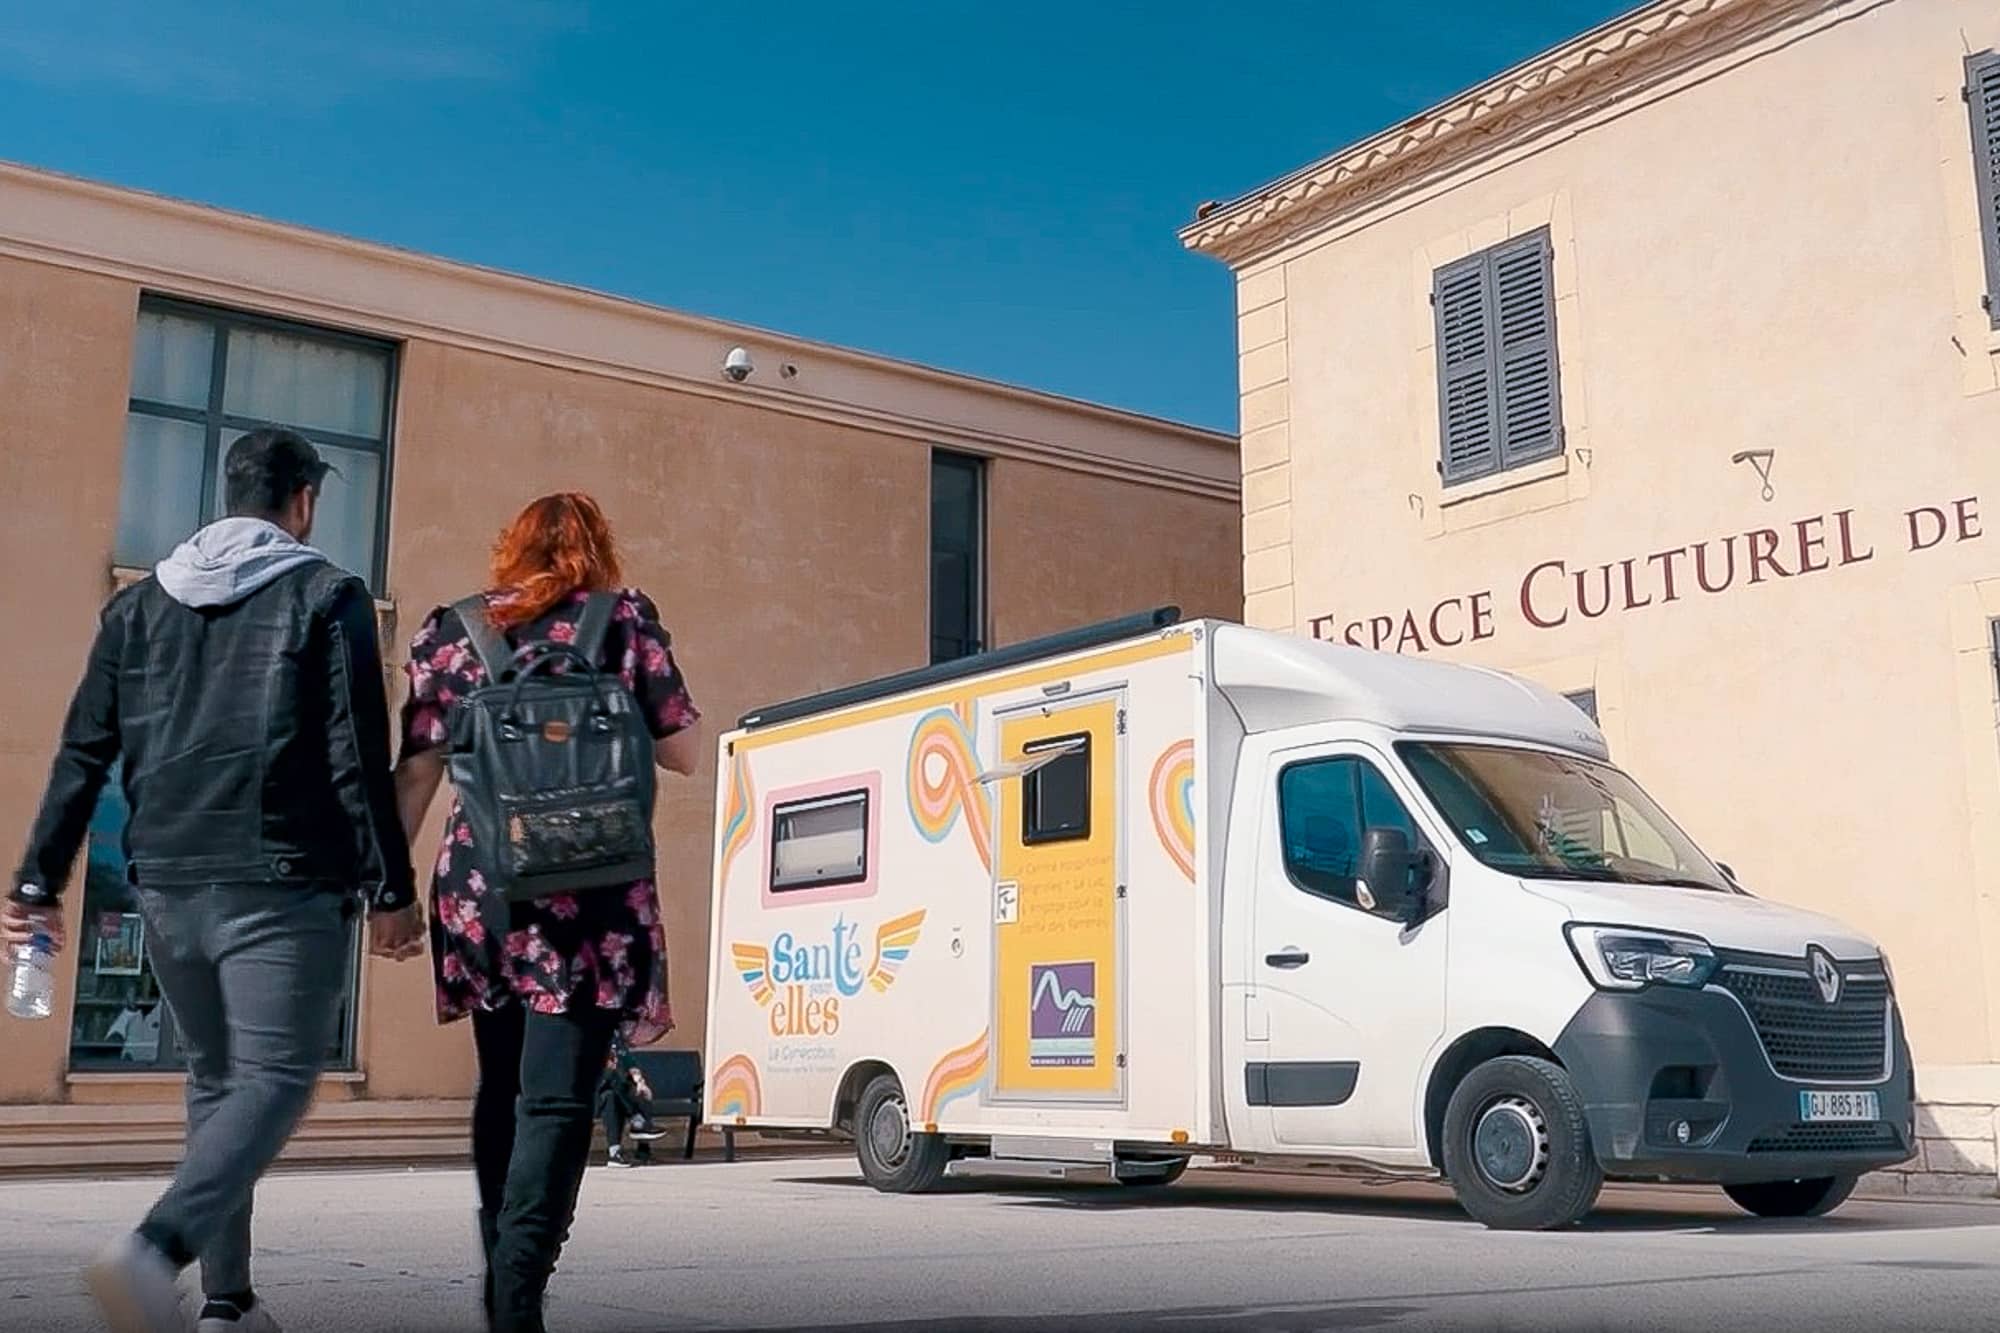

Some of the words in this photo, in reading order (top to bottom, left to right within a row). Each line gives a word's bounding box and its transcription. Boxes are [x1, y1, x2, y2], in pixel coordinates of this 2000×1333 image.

[1307, 590, 1496, 654] ESPACE
[1519, 508, 1874, 629] CULTUREL
[1904, 496, 1983, 552] DE
[772, 911, 864, 997] Santé
[769, 984, 840, 1037] elles
